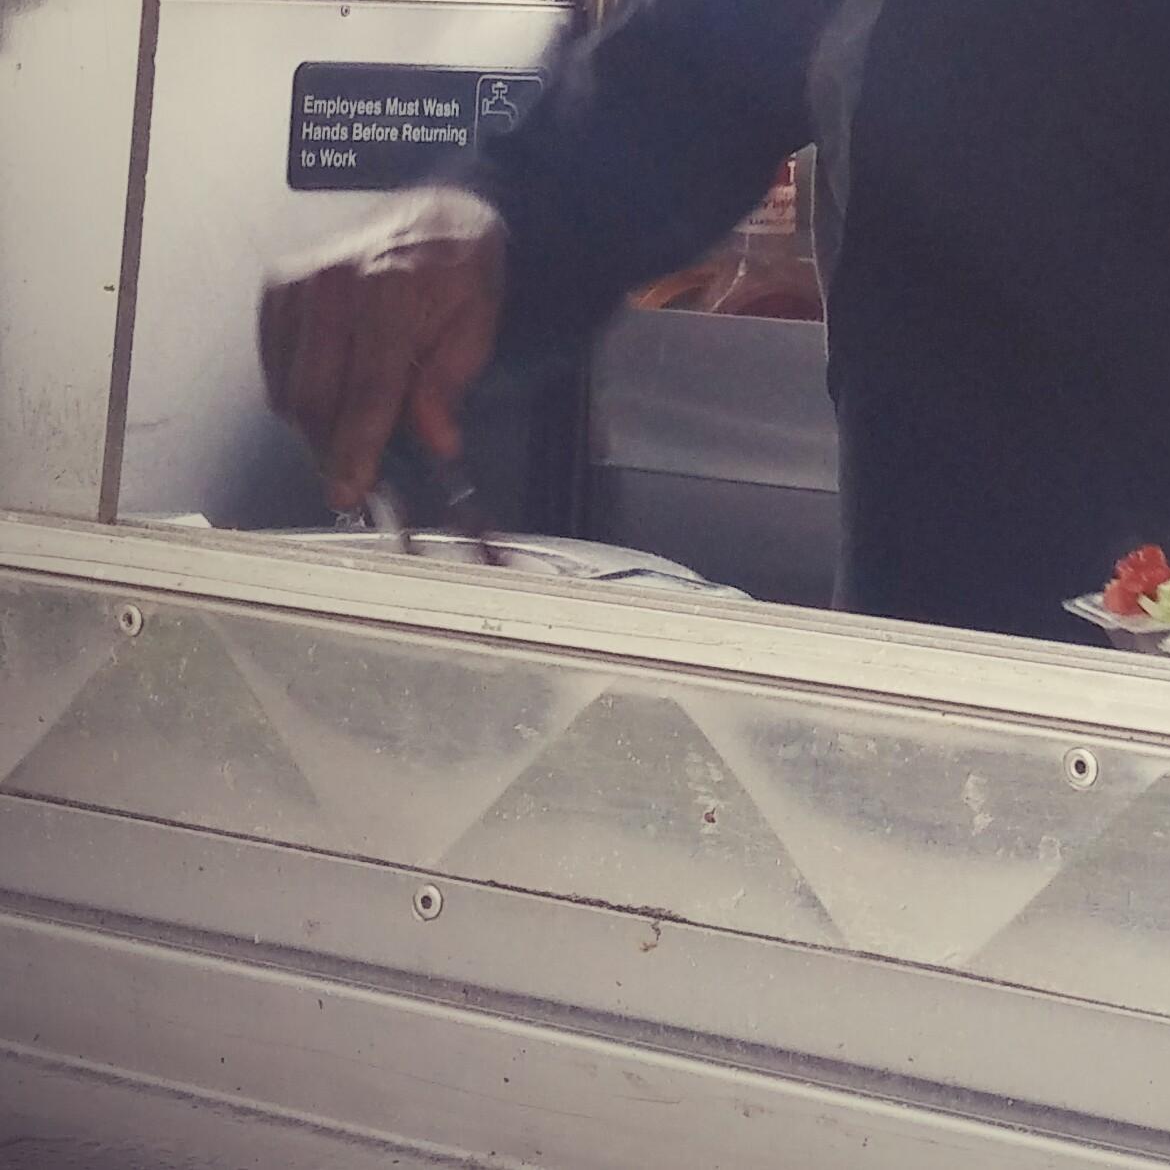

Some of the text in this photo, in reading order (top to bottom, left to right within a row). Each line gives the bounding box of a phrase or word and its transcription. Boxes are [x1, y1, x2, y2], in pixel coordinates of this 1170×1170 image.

[304, 95, 459, 118] Employees Must Wash
[301, 121, 467, 147] Hands Before Returning
[301, 148, 357, 168] to Work
